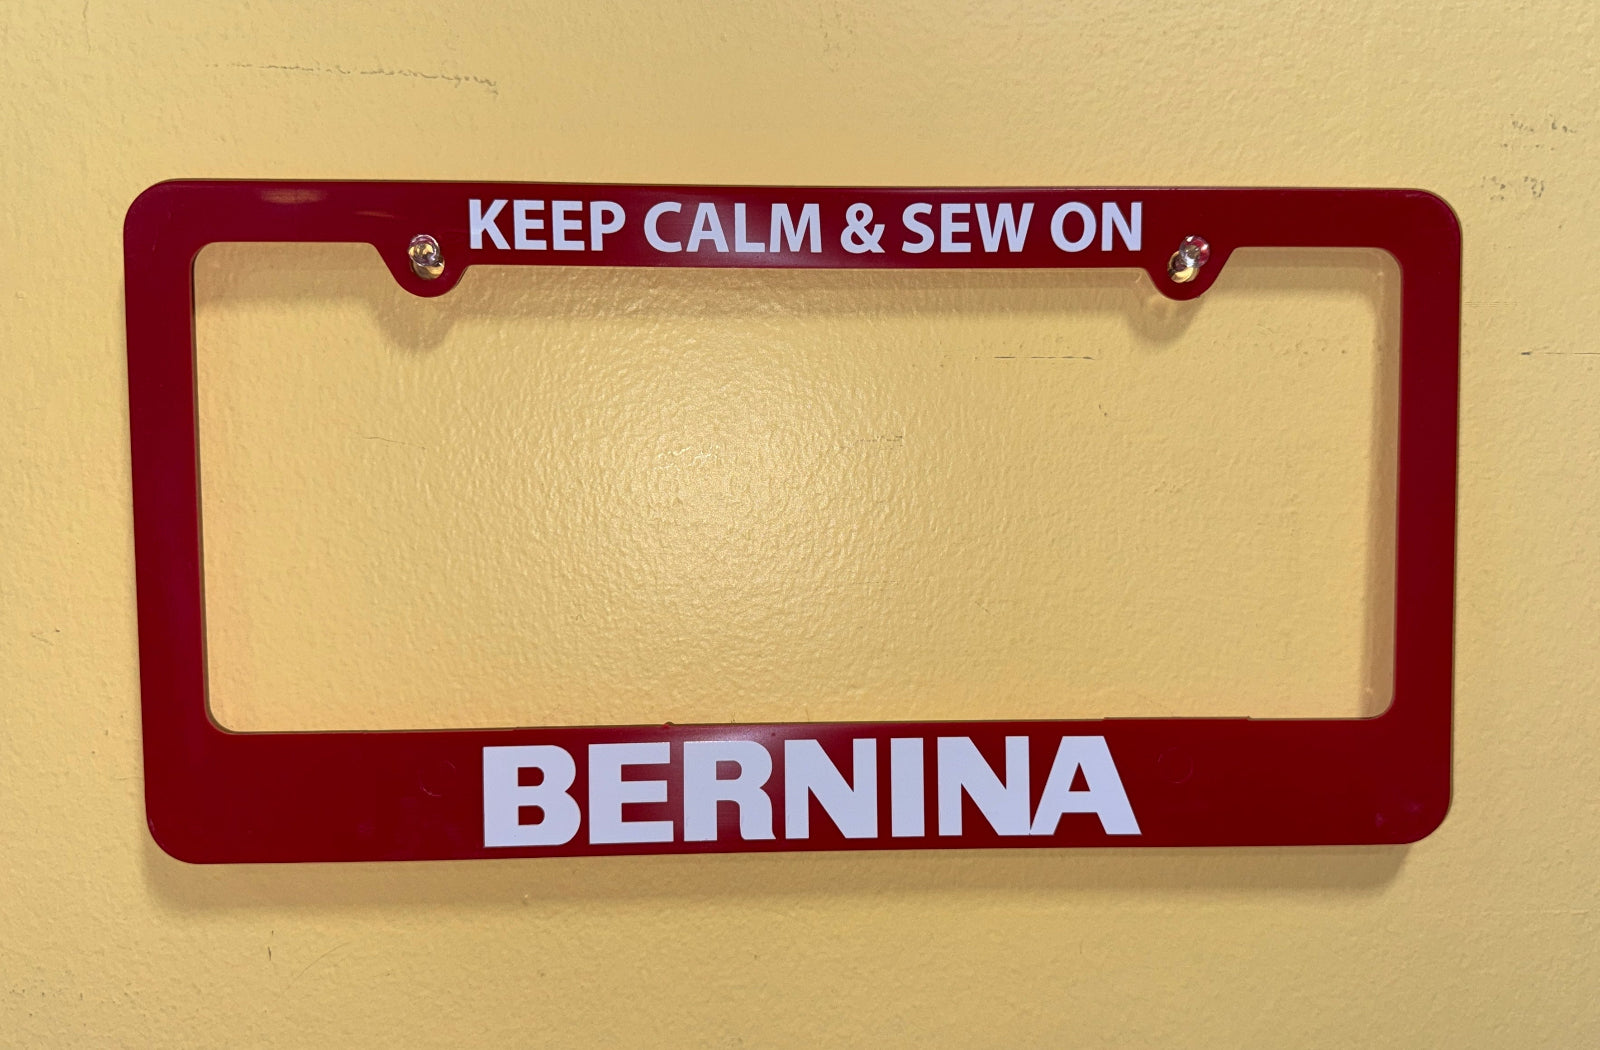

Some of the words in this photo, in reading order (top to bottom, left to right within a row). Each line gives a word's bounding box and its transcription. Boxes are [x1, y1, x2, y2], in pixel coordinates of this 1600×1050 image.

[468, 198, 626, 252] KEEP
[643, 201, 823, 255] CALM
[840, 202, 886, 255] &
[900, 201, 1035, 255] SEW
[1050, 200, 1143, 253] ON
[482, 734, 1142, 849] BERNINA
